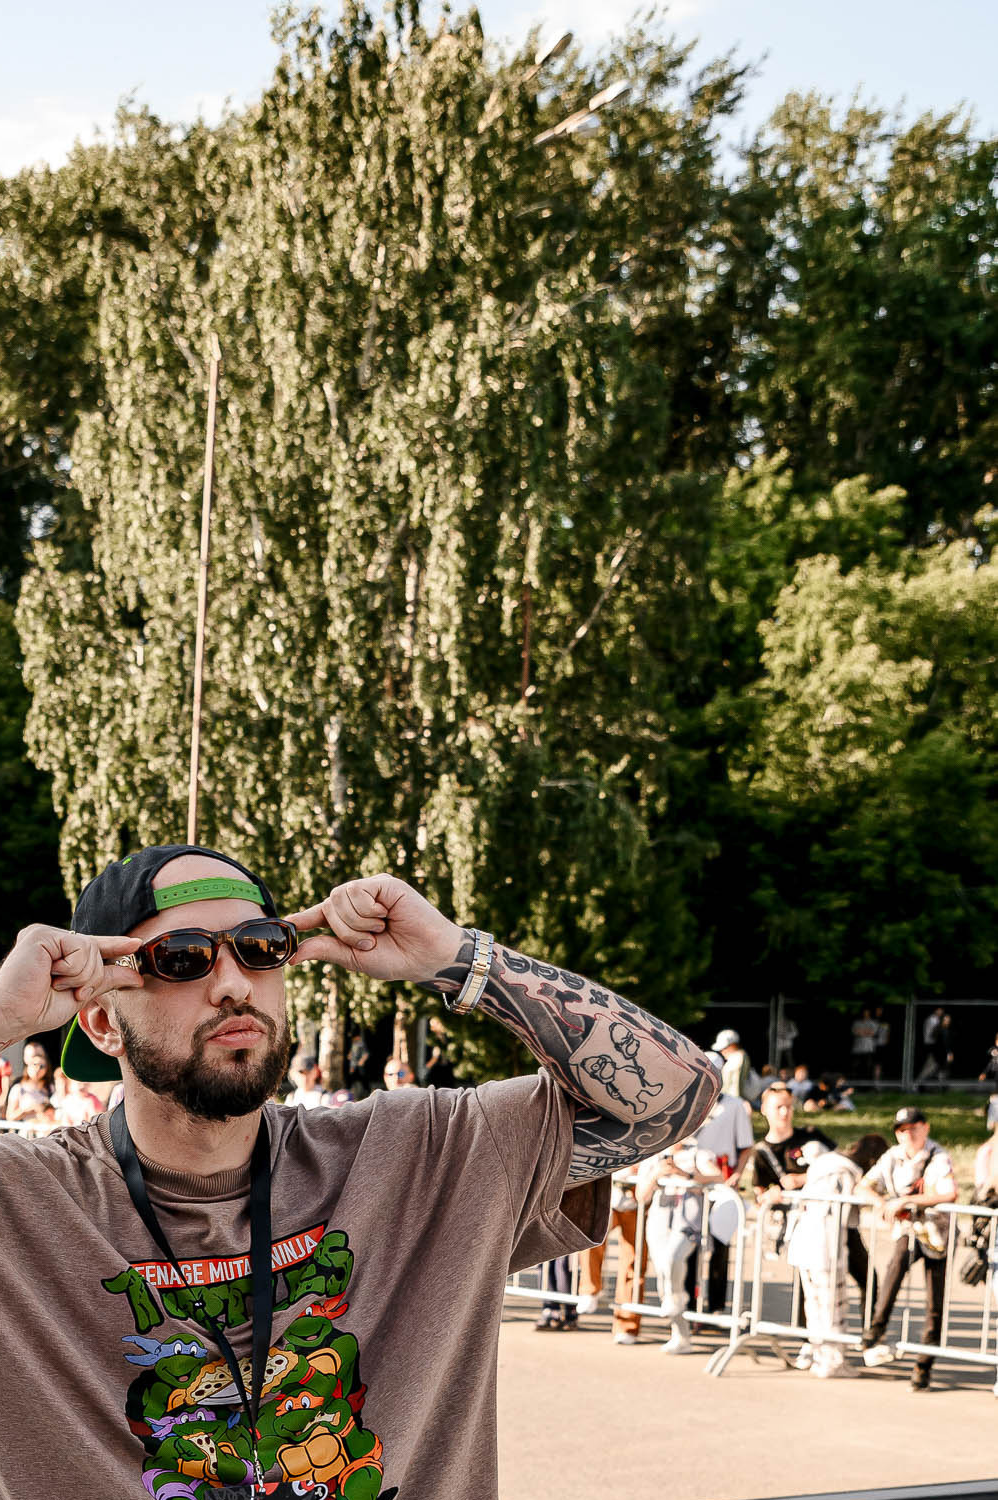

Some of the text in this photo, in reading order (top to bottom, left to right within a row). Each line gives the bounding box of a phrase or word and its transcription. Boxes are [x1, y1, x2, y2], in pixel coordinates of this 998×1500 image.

[134, 1234, 318, 1286] EENAGE MUTA NINJA
